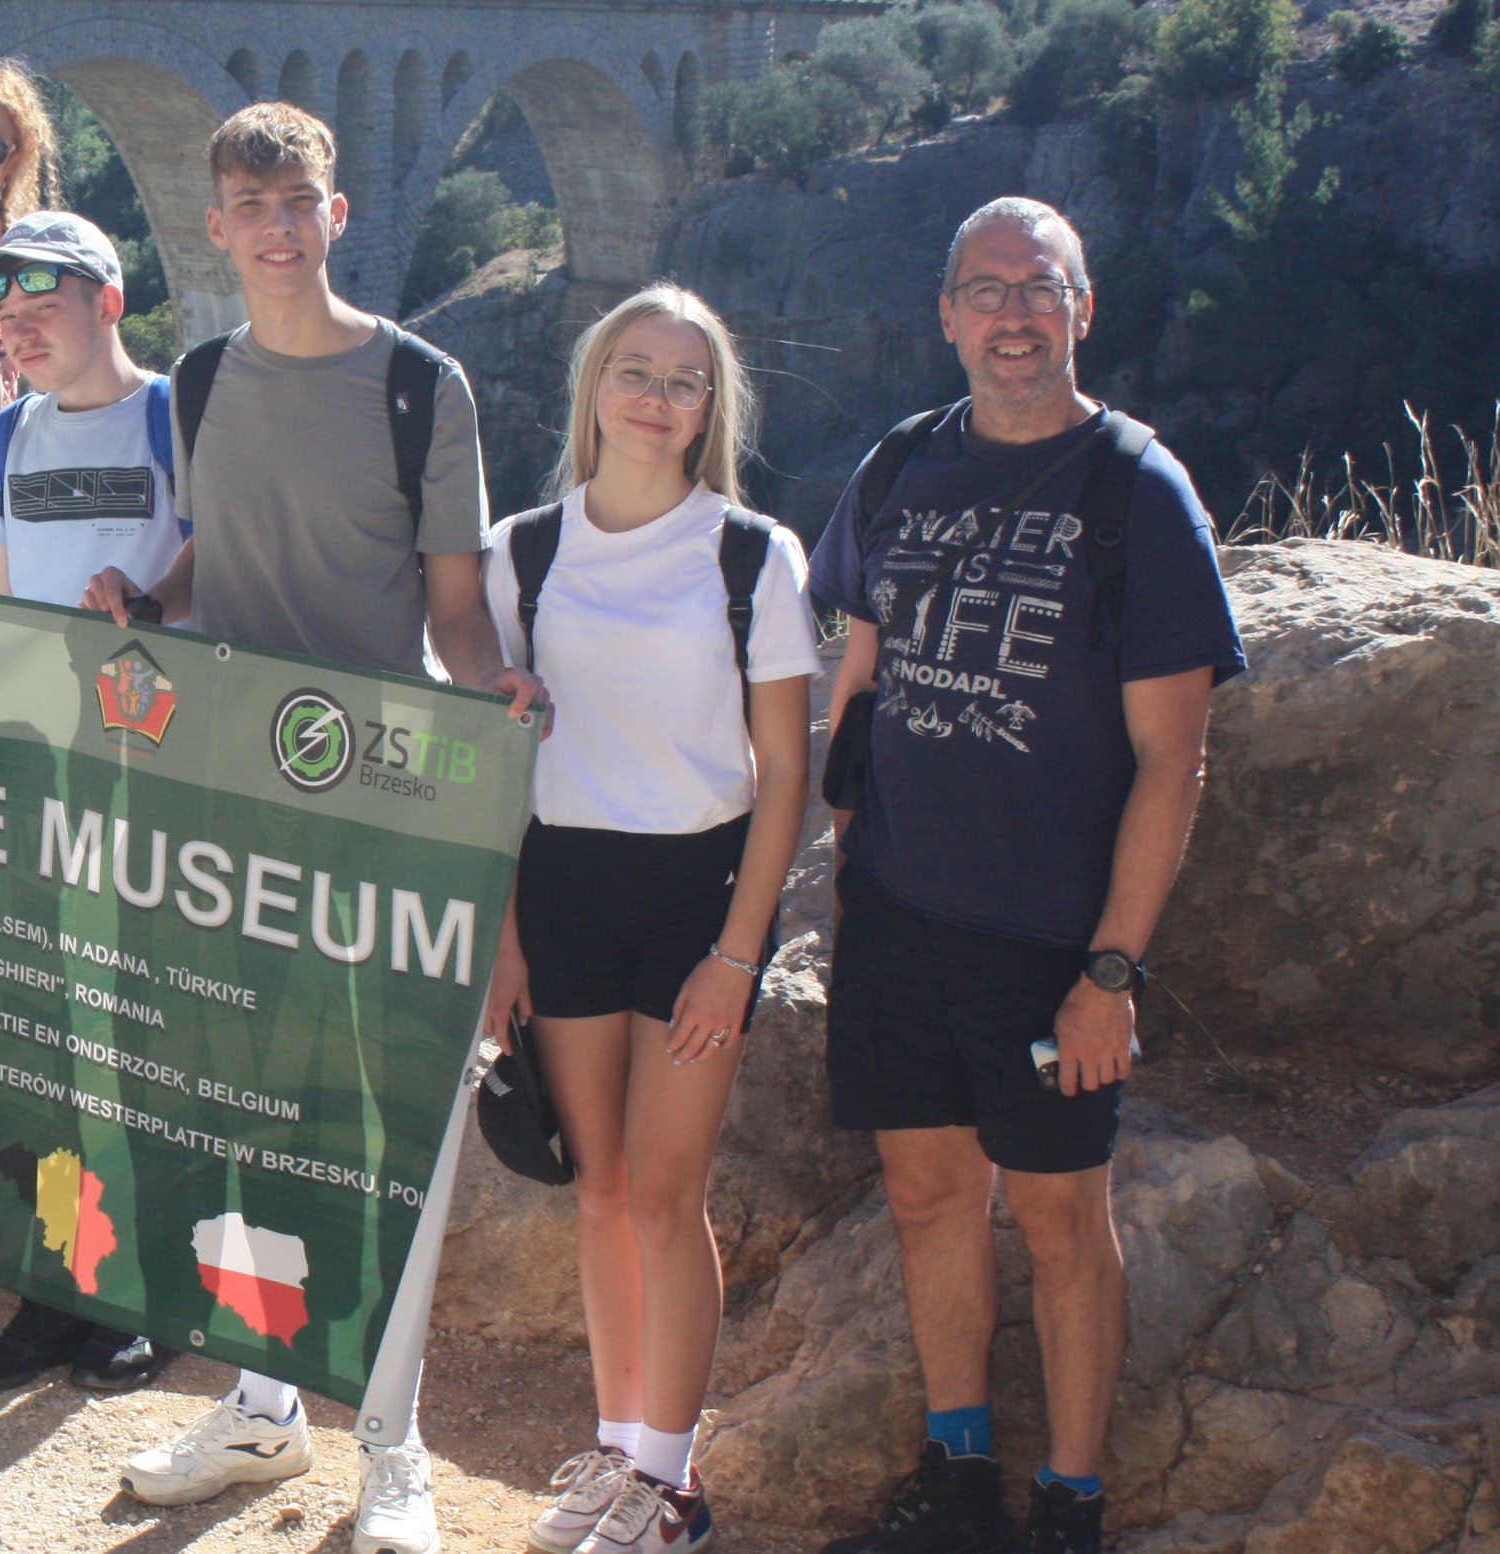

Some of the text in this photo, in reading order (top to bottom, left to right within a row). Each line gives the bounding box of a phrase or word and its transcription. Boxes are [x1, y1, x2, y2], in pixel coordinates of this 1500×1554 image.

[952, 553, 991, 583] IS
[891, 657, 1007, 700] #NODAPL
[360, 763, 436, 801] Brzesko
[362, 720, 477, 784] ZSTiB
[39, 796, 476, 987] MUSEUM
[59, 932, 77, 955] IN
[81, 941, 150, 979] ADANA
[166, 966, 256, 1010] TÜRKIYE
[75, 982, 165, 1029] ROMANIA
[34, 1023, 60, 1047] EN
[66, 1034, 190, 1095] ONDERZOEK,
[198, 1078, 300, 1121] BELGIUM
[70, 1088, 227, 1158] WESTERPLATTE
[232, 1142, 255, 1164] W
[262, 1150, 381, 1199] BRZESKU,
